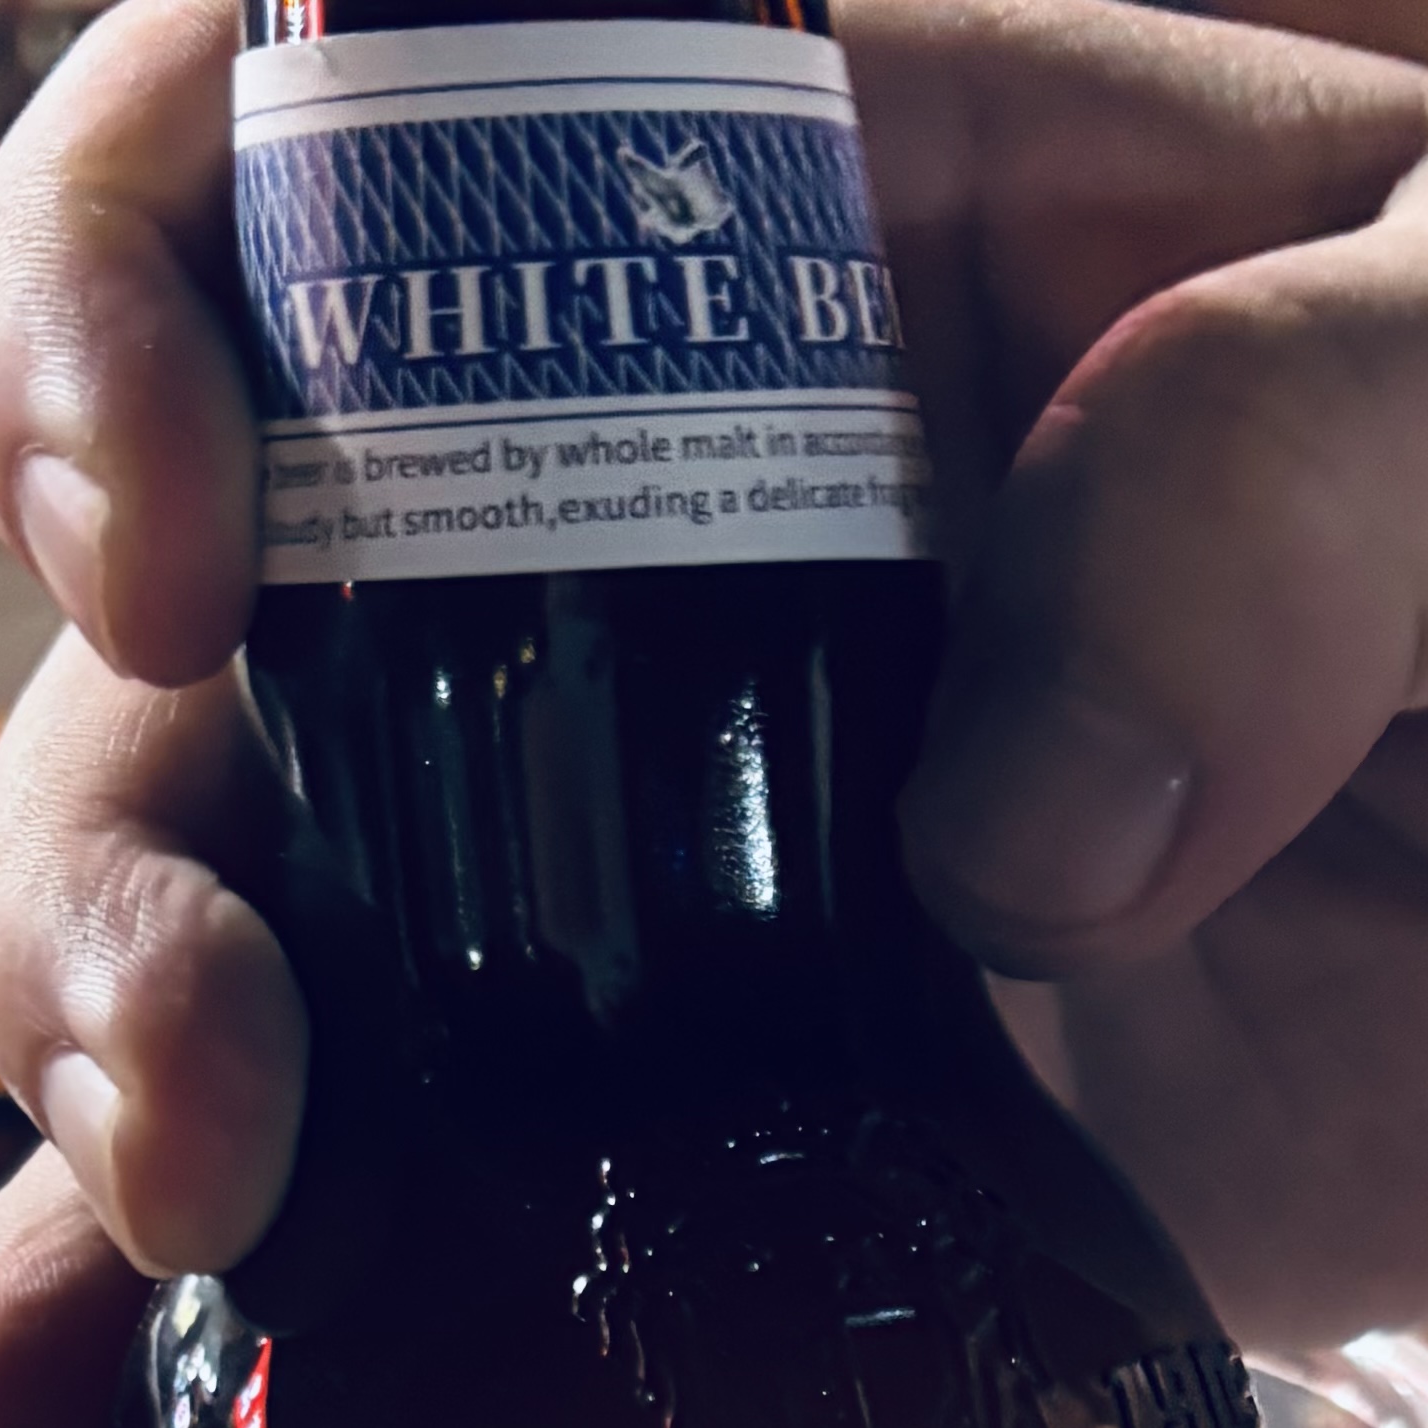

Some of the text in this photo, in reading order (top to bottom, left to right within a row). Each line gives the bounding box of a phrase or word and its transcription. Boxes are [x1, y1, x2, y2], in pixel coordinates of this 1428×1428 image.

[288, 256, 749, 369] WHITE
[365, 440, 491, 482] brewed
[502, 437, 548, 480] by
[556, 427, 673, 466] whole
[680, 424, 761, 459] malt
[342, 505, 398, 542] but
[719, 489, 740, 514] a
